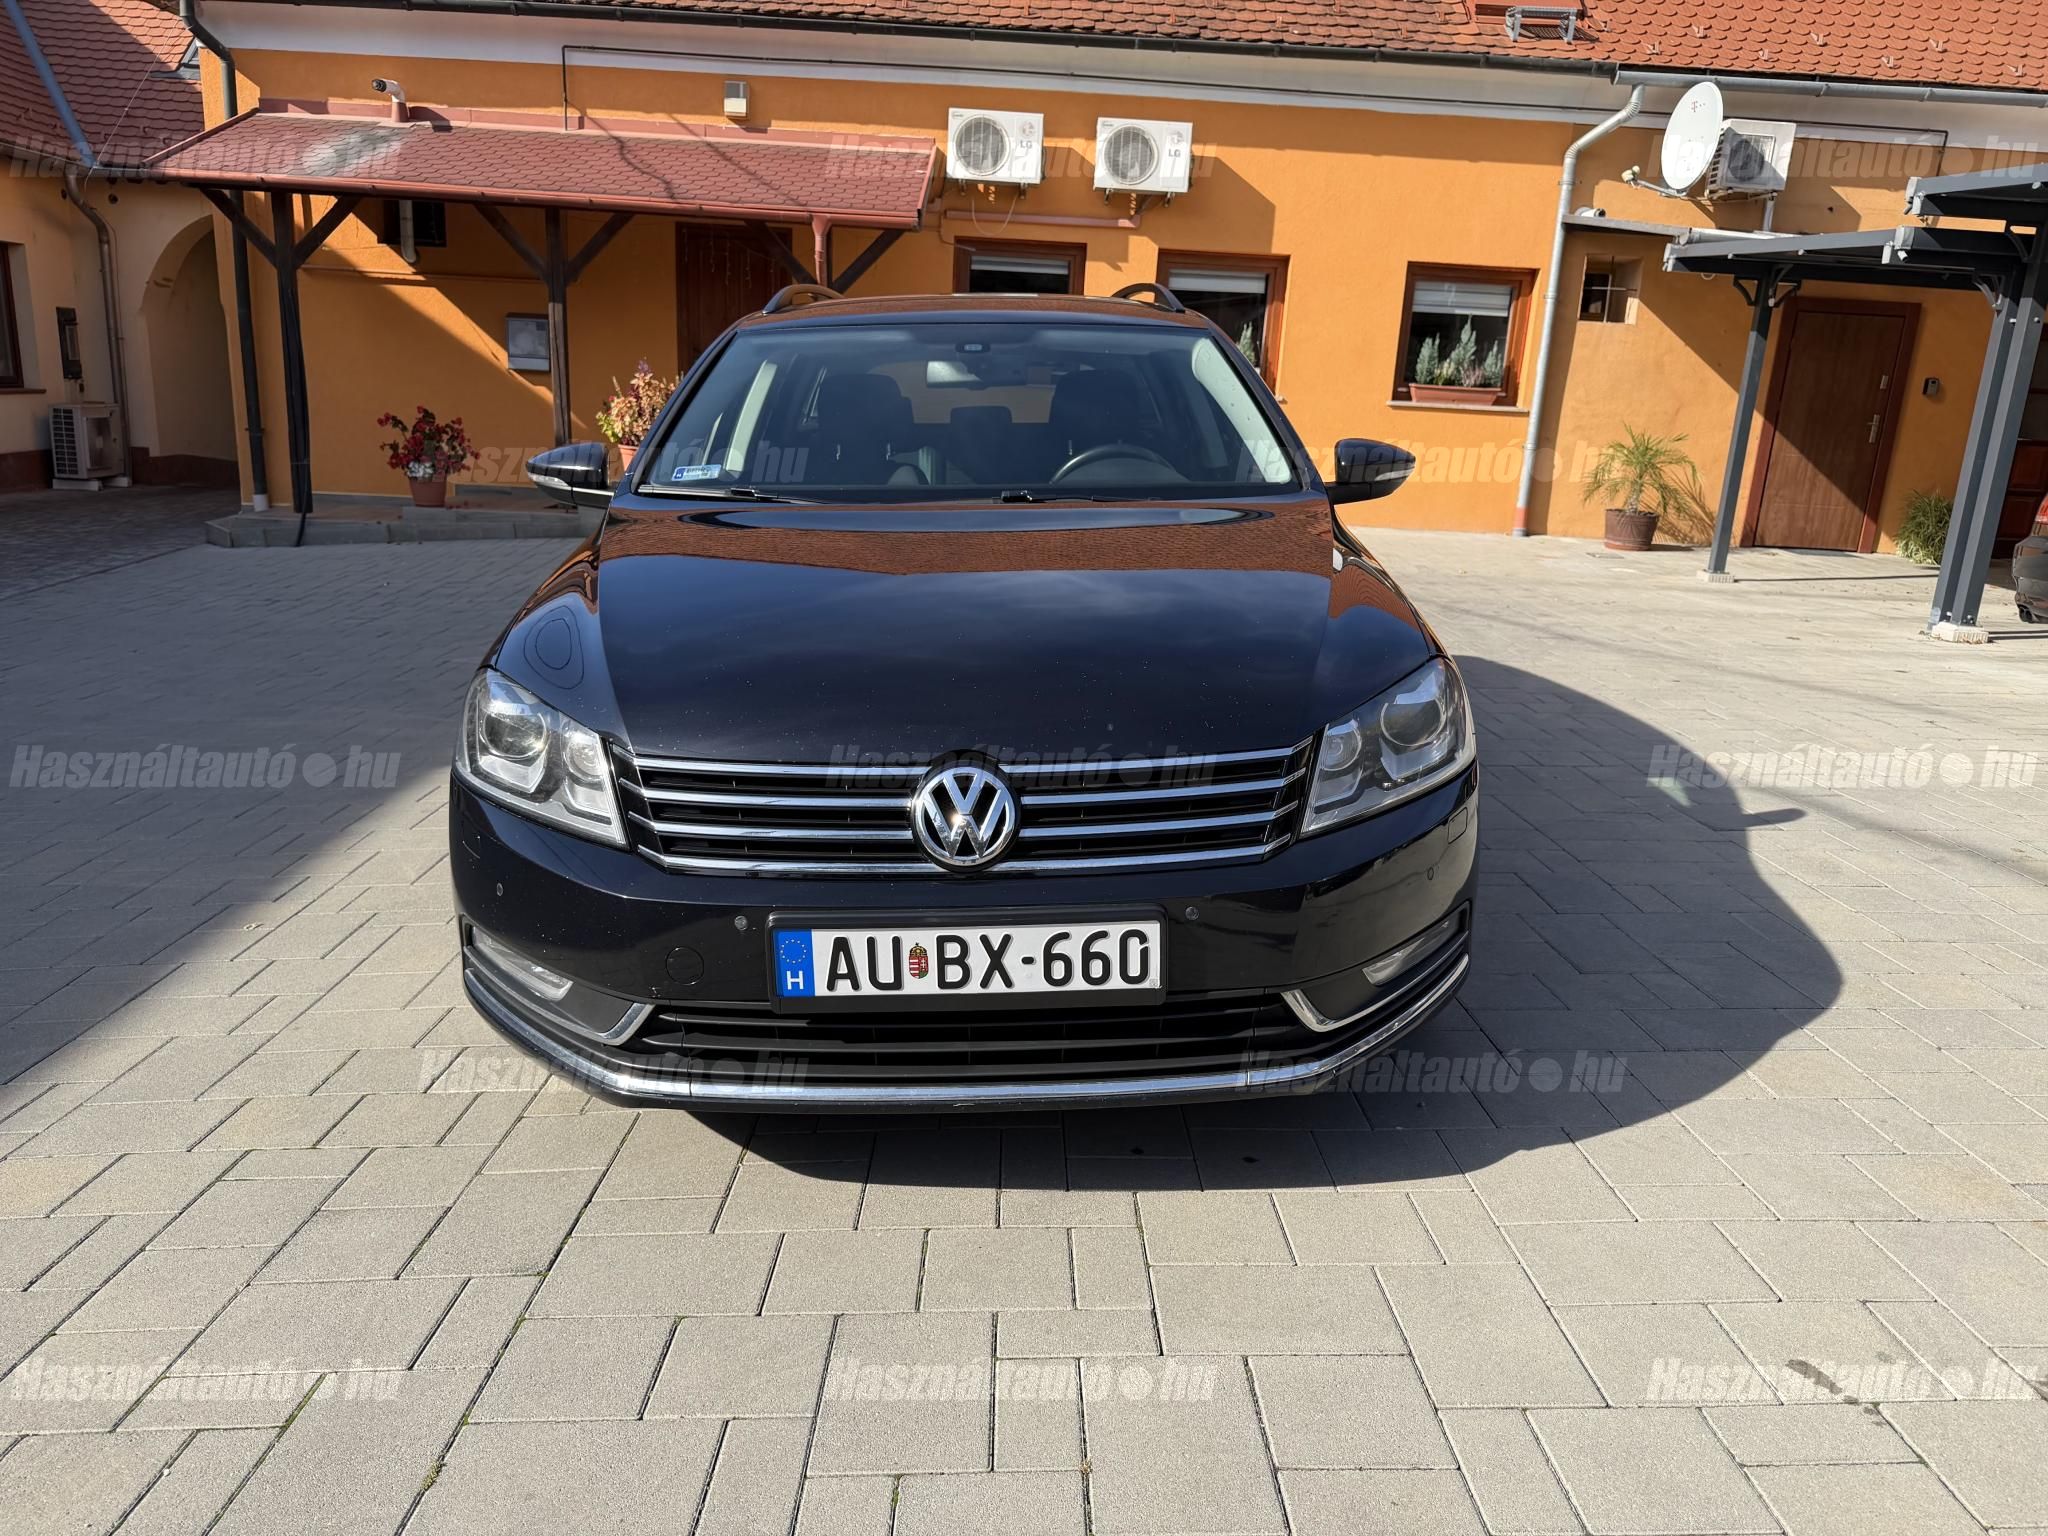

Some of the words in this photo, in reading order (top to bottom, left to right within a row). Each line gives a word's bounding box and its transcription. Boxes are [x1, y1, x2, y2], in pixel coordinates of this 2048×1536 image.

[1020, 139, 1033, 149] LG
[1168, 148, 1181, 158] LG
[826, 936, 902, 991] AU
[787, 970, 804, 990] H
